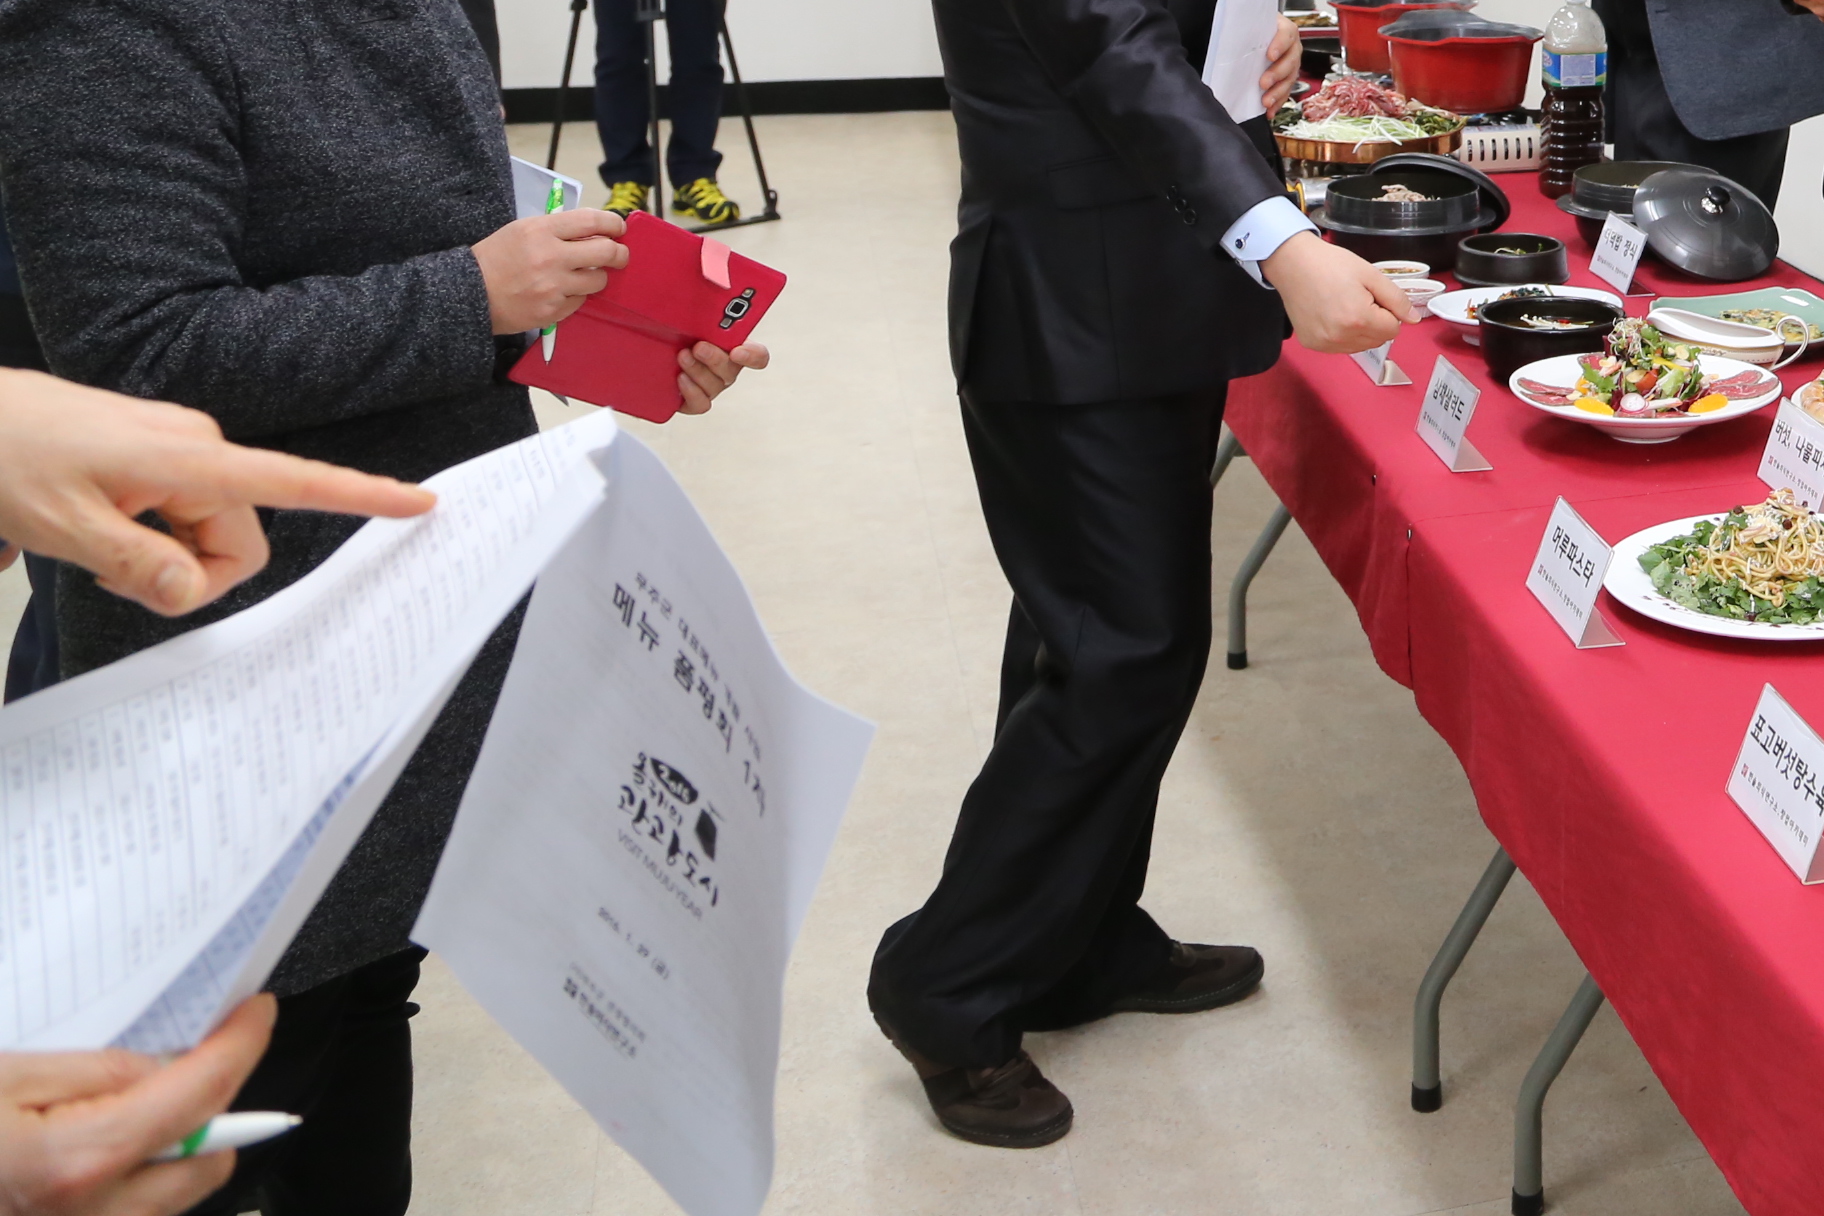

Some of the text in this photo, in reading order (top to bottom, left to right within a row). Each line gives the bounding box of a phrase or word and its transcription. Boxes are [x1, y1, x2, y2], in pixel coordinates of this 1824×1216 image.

[1552, 525, 1595, 588] 머루파스타
[612, 582, 660, 652] 메뉴
[674, 649, 733, 754] 품평회
